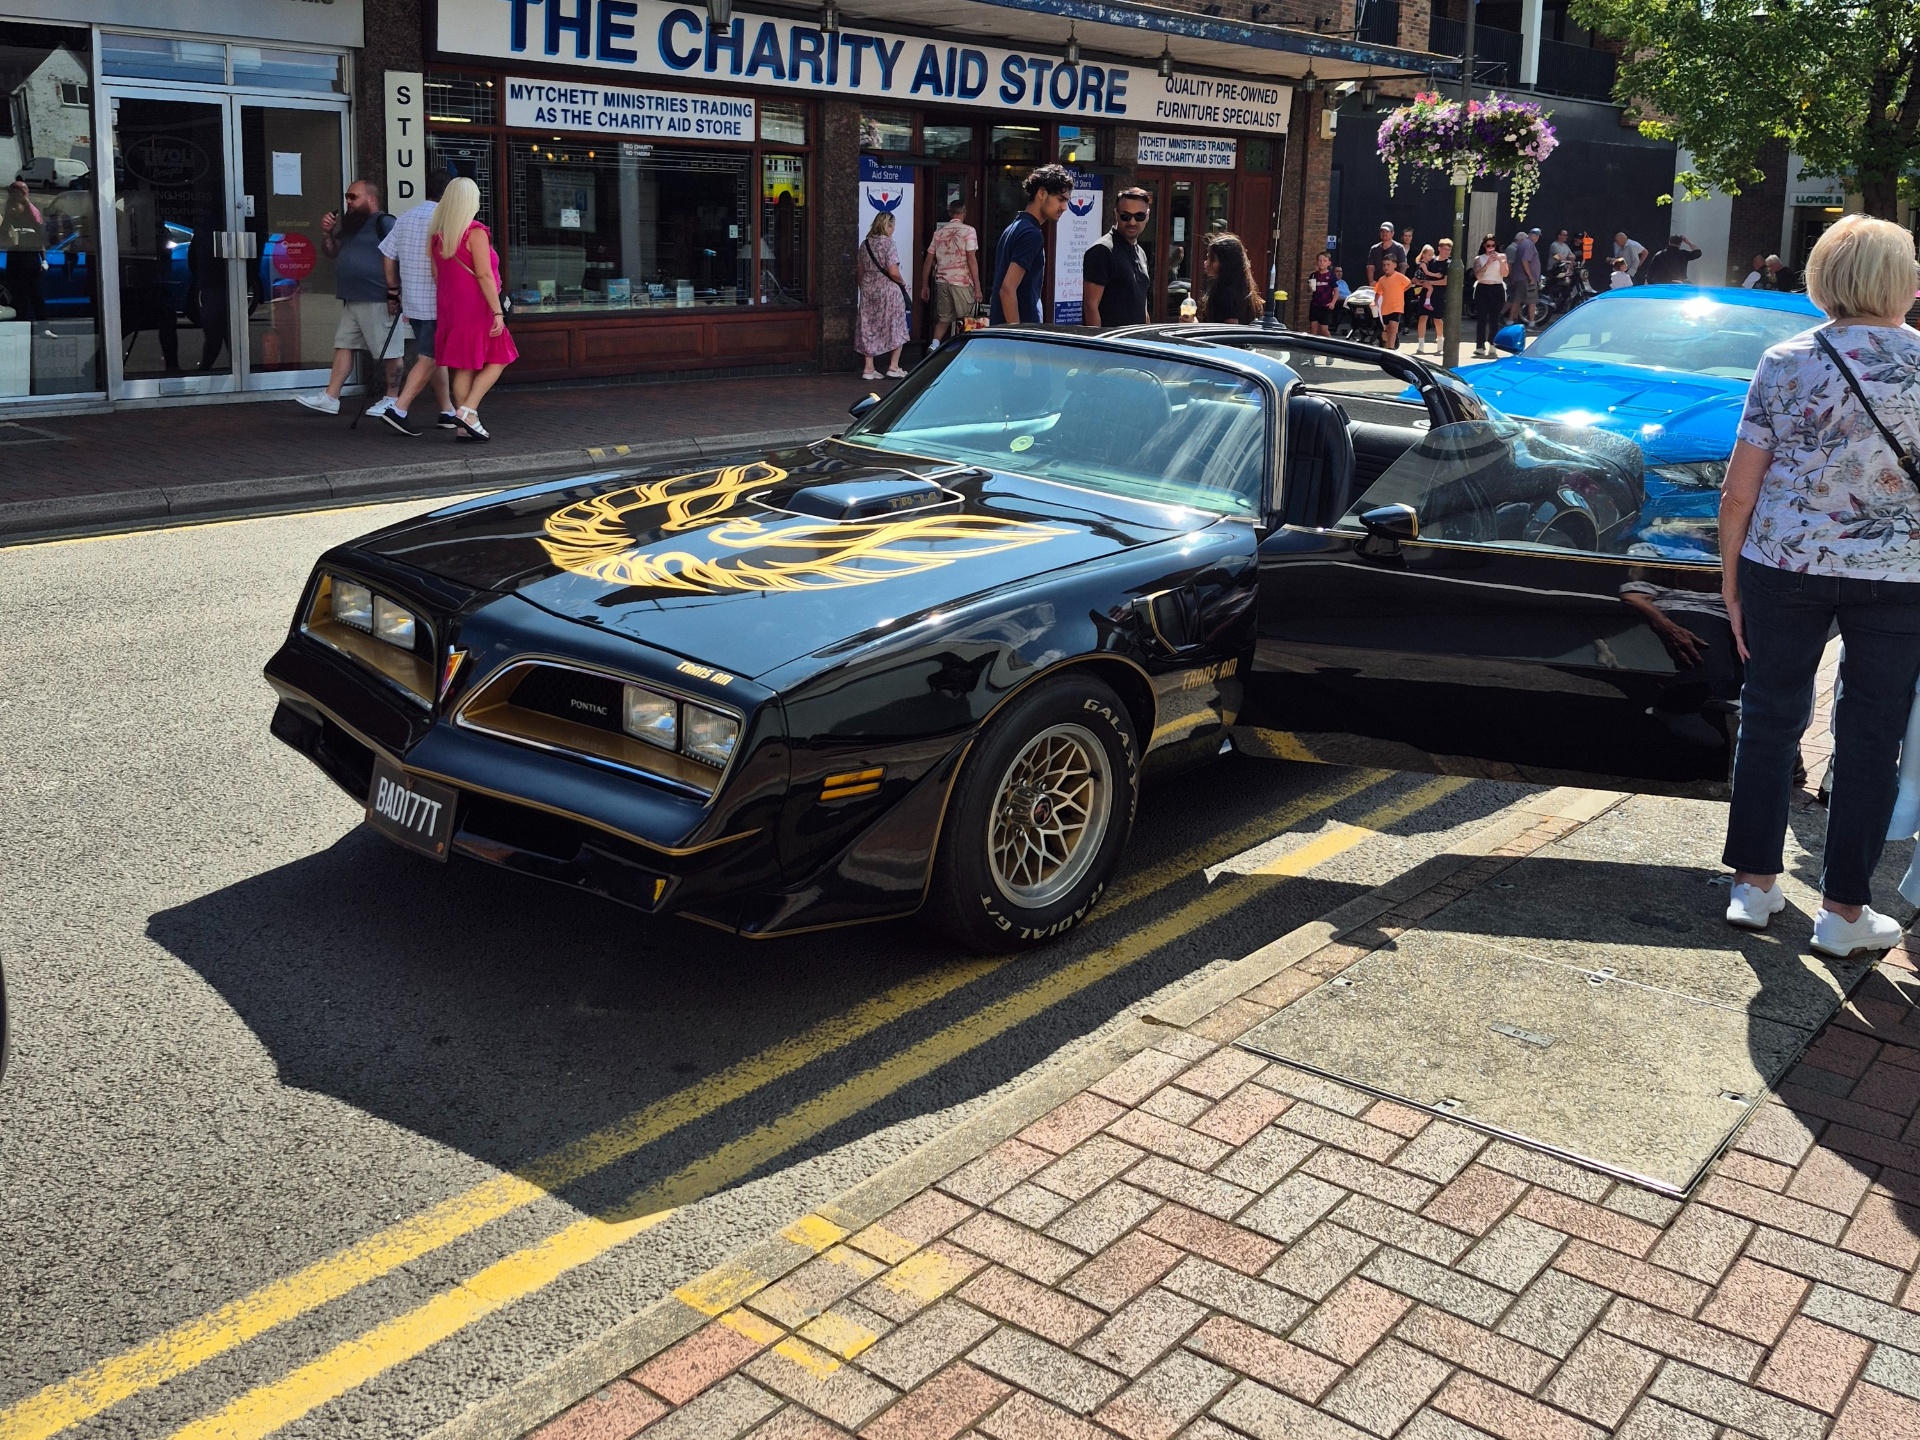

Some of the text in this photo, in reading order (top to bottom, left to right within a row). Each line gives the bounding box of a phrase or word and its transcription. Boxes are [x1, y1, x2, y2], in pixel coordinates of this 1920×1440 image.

[507, 0, 1129, 115] THE CHARITY AID STORE
[510, 84, 752, 118] MYTCHETT MINISTRIES TRADING
[1165, 77, 1278, 105] QUALITY PRE-OWNED
[535, 107, 741, 135] AS THE CHARITY AID STORE
[1157, 101, 1281, 127] FURNITURE SPECIALIST
[1138, 150, 1230, 165] AS THE CHARITY AID STORE
[1169, 138, 1206, 151] MINISTRIES
[1208, 141, 1236, 153] TRADING
[872, 171, 899, 180] Aid Store
[1796, 196, 1833, 204] LLOYDS
[676, 661, 734, 686] TRANS AM
[1182, 657, 1239, 690] TRANS AM
[571, 699, 607, 716] PONTIAC
[1083, 699, 1137, 791] GALAXY
[376, 776, 442, 837] BAD177T
[1021, 882, 1103, 939] RADIAL
